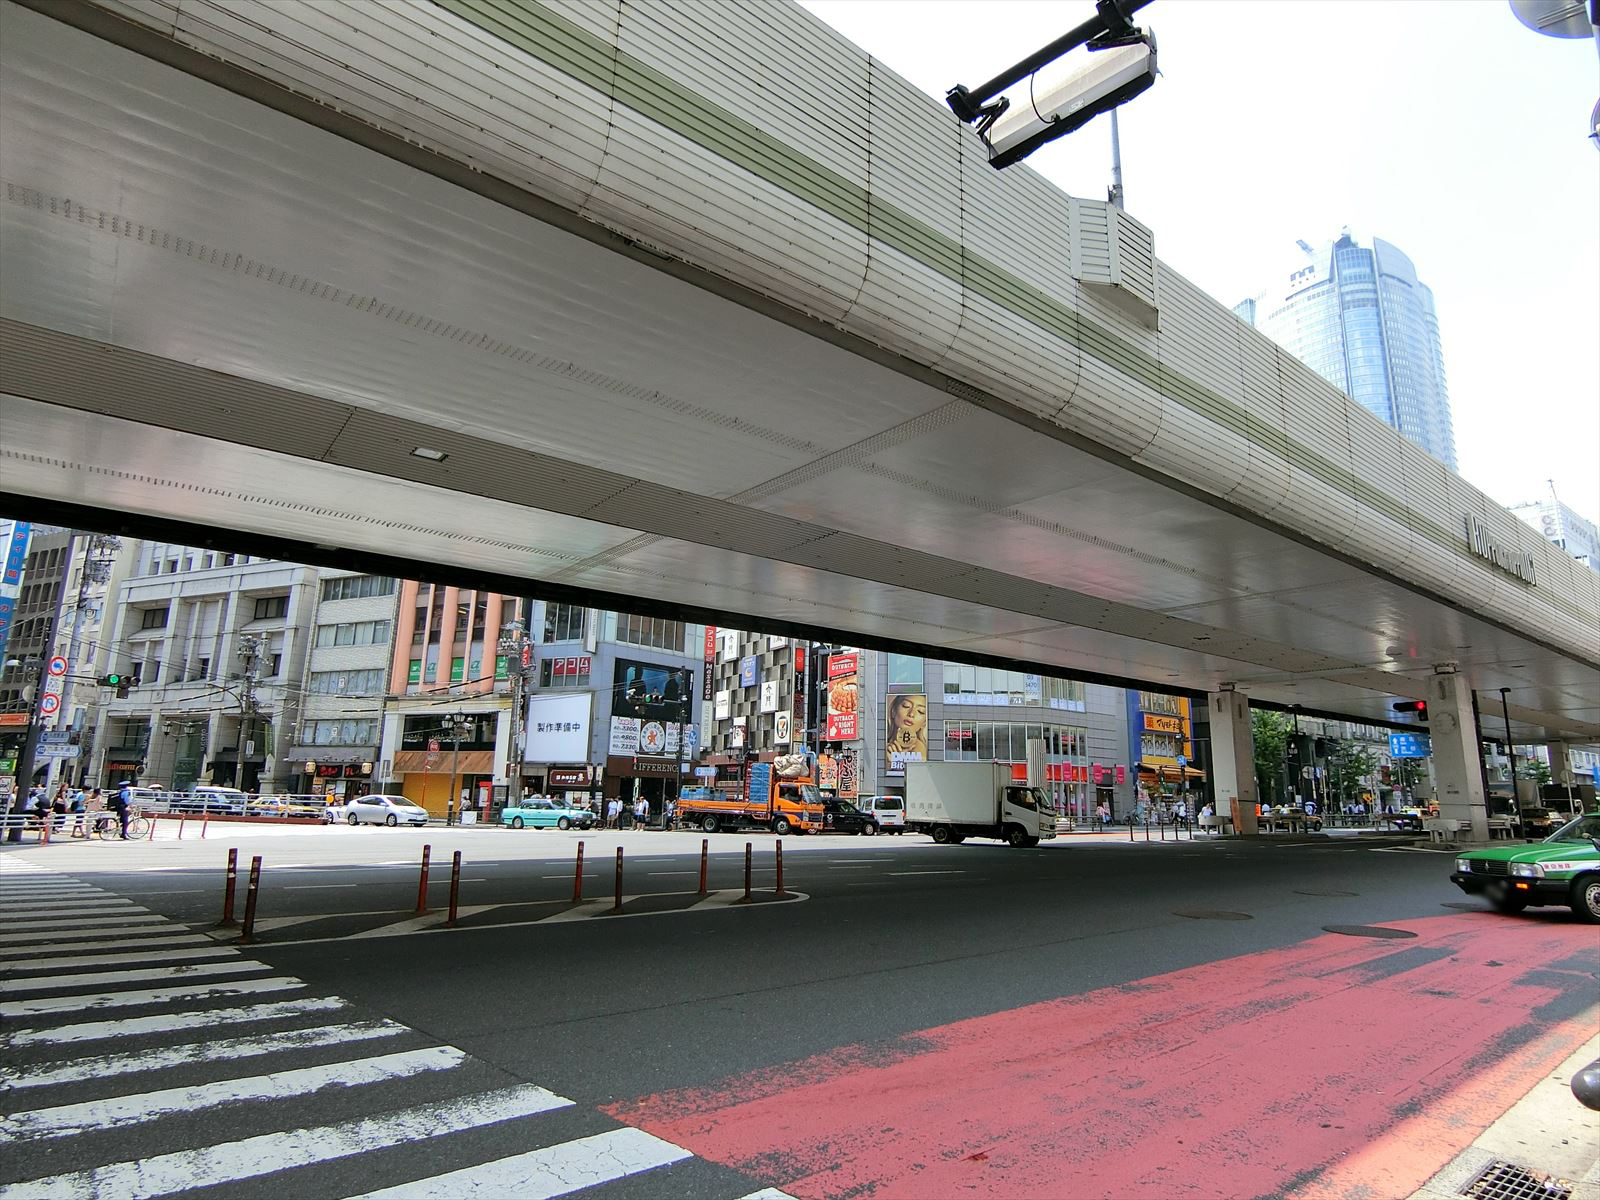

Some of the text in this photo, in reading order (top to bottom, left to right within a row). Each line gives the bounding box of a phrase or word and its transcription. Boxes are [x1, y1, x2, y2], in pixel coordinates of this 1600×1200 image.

[555, 658, 589, 669] アコム
[831, 663, 854, 671] OUTBACK
[537, 722, 580, 733] 製作準備中
